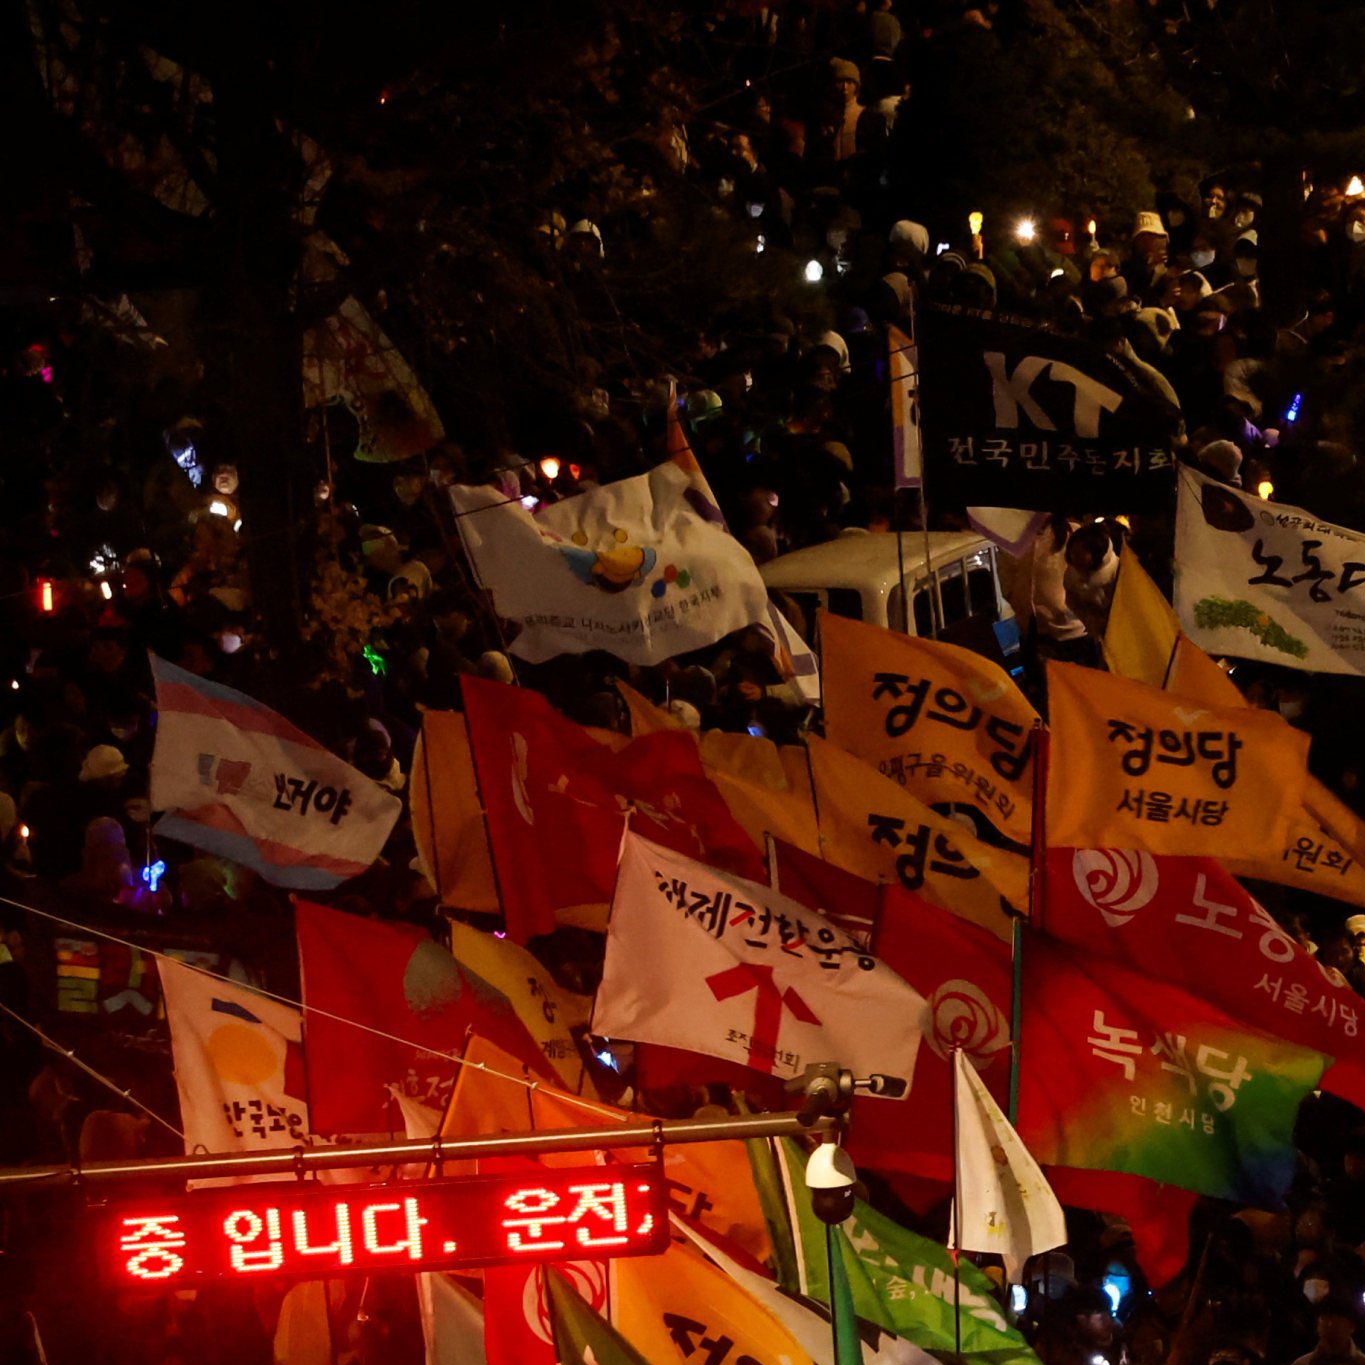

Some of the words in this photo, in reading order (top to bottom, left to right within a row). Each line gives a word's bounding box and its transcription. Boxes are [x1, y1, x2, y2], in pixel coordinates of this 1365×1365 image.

[983, 350, 1124, 439] KT
[872, 671, 1032, 781] 정의당
[1107, 718, 1243, 789] 정의당
[1117, 788, 1229, 827] 서울시당
[1283, 836, 1353, 876] 원회
[1254, 972, 1361, 1039] 서울시당
[1087, 1009, 1254, 1113] 녹색당
[1129, 1093, 1217, 1135] 인천시당
[120, 1214, 187, 1281] 중
[222, 1197, 459, 1273] 입니다.
